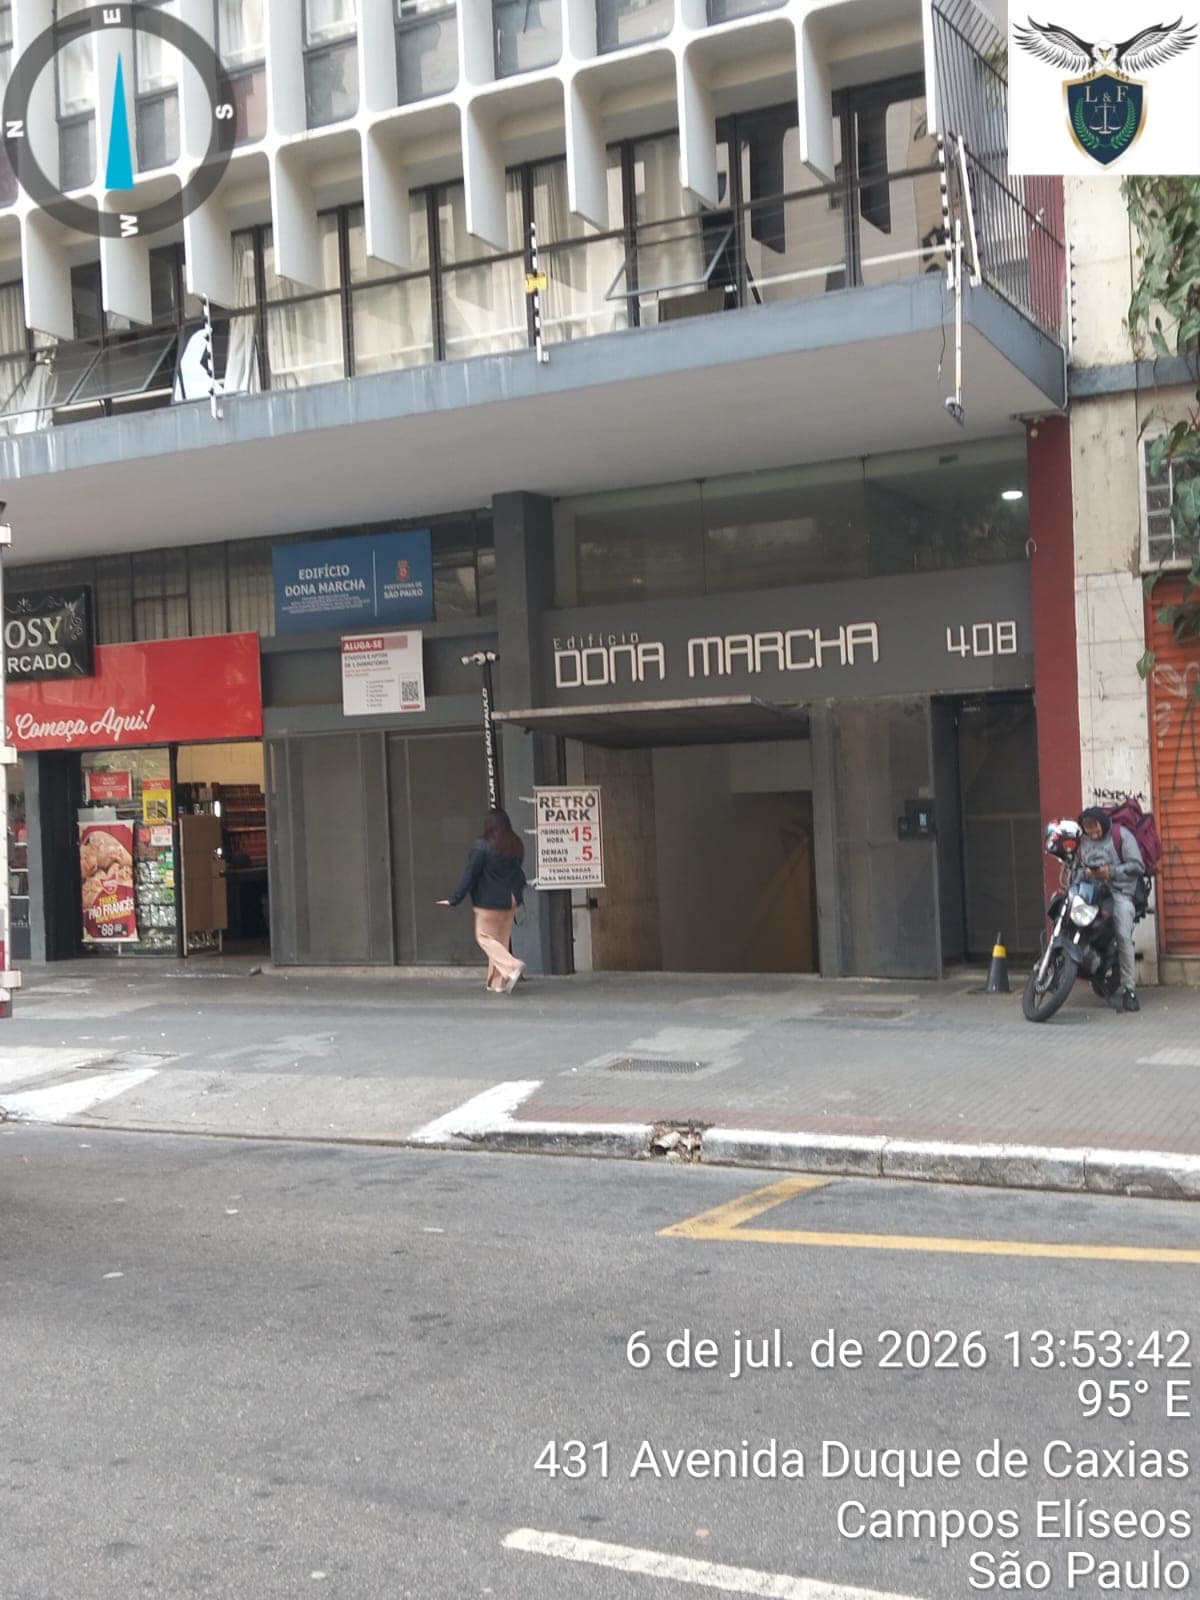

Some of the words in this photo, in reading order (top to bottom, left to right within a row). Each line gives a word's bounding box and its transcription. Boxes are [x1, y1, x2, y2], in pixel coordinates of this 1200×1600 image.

[298, 563, 350, 581] EDIFÍCIO
[285, 584, 316, 597] DONA
[318, 578, 366, 595] MARCHA
[399, 588, 423, 599] PAULO
[5, 616, 62, 649] OSY
[946, 620, 1017, 658] 408
[343, 639, 383, 651] ALUGA-SE
[7, 652, 71, 673] RCADO
[554, 642, 665, 688] DONA
[687, 621, 879, 678] MARCHA
[15, 713, 89, 742] Começa
[90, 704, 155, 741] Aqui!
[540, 792, 596, 809] RETRÔ
[545, 809, 591, 822] PARK
[541, 828, 570, 836] PRIMEIRA
[571, 825, 593, 842] 15
[541, 848, 569, 856] DEMAIS
[582, 845, 593, 861] 5
